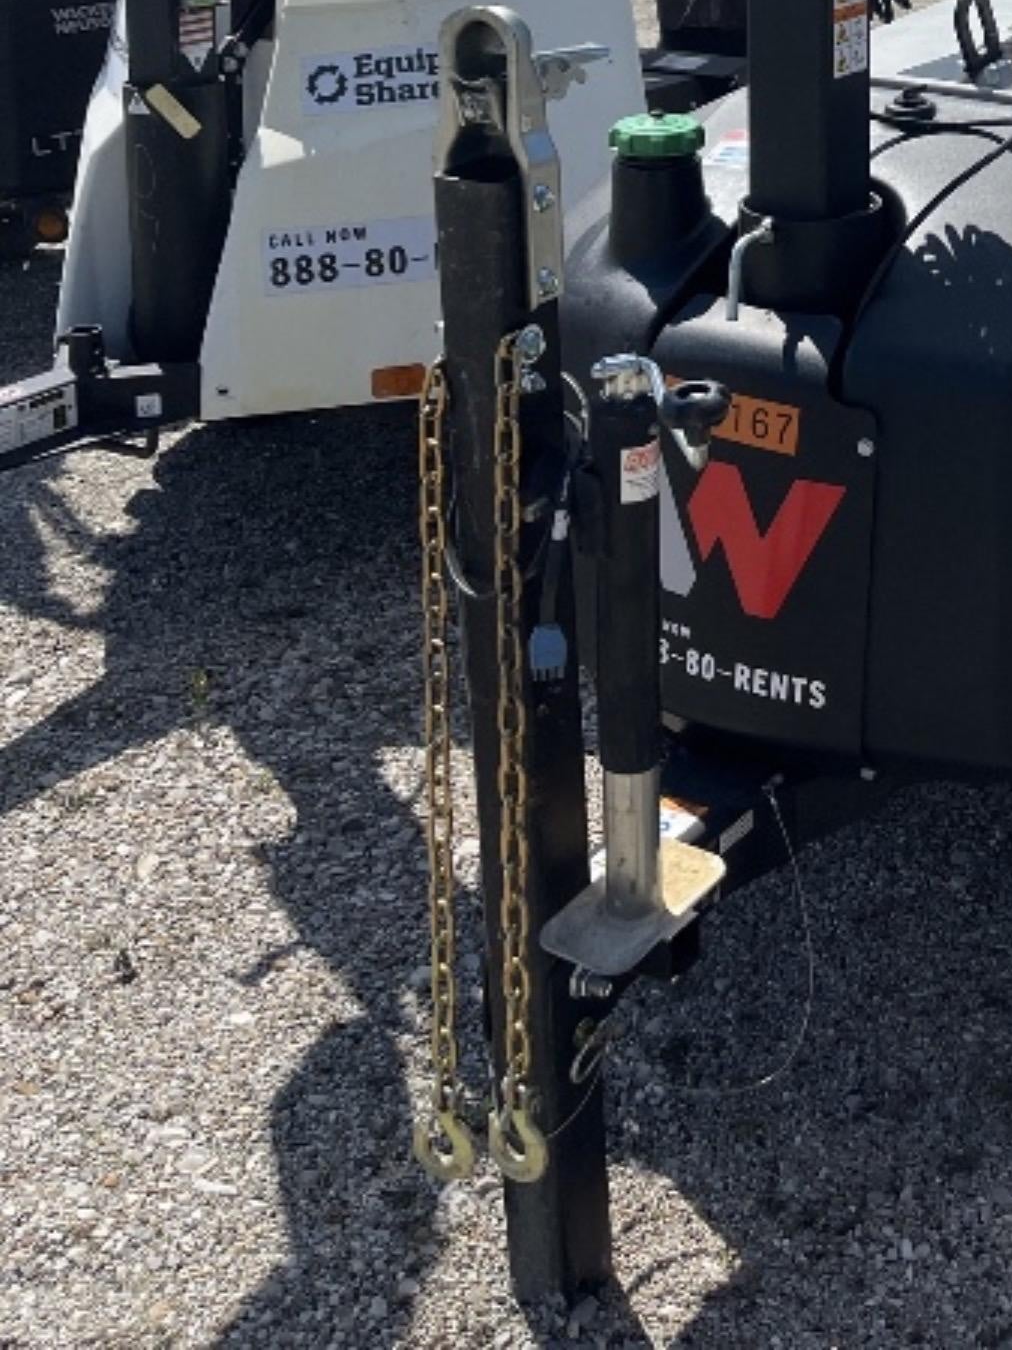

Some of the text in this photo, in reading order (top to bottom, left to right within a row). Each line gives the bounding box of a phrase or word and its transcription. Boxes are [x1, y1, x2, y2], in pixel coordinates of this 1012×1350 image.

[269, 226, 367, 250] CALL NOW
[270, 242, 440, 288] 888-80-
